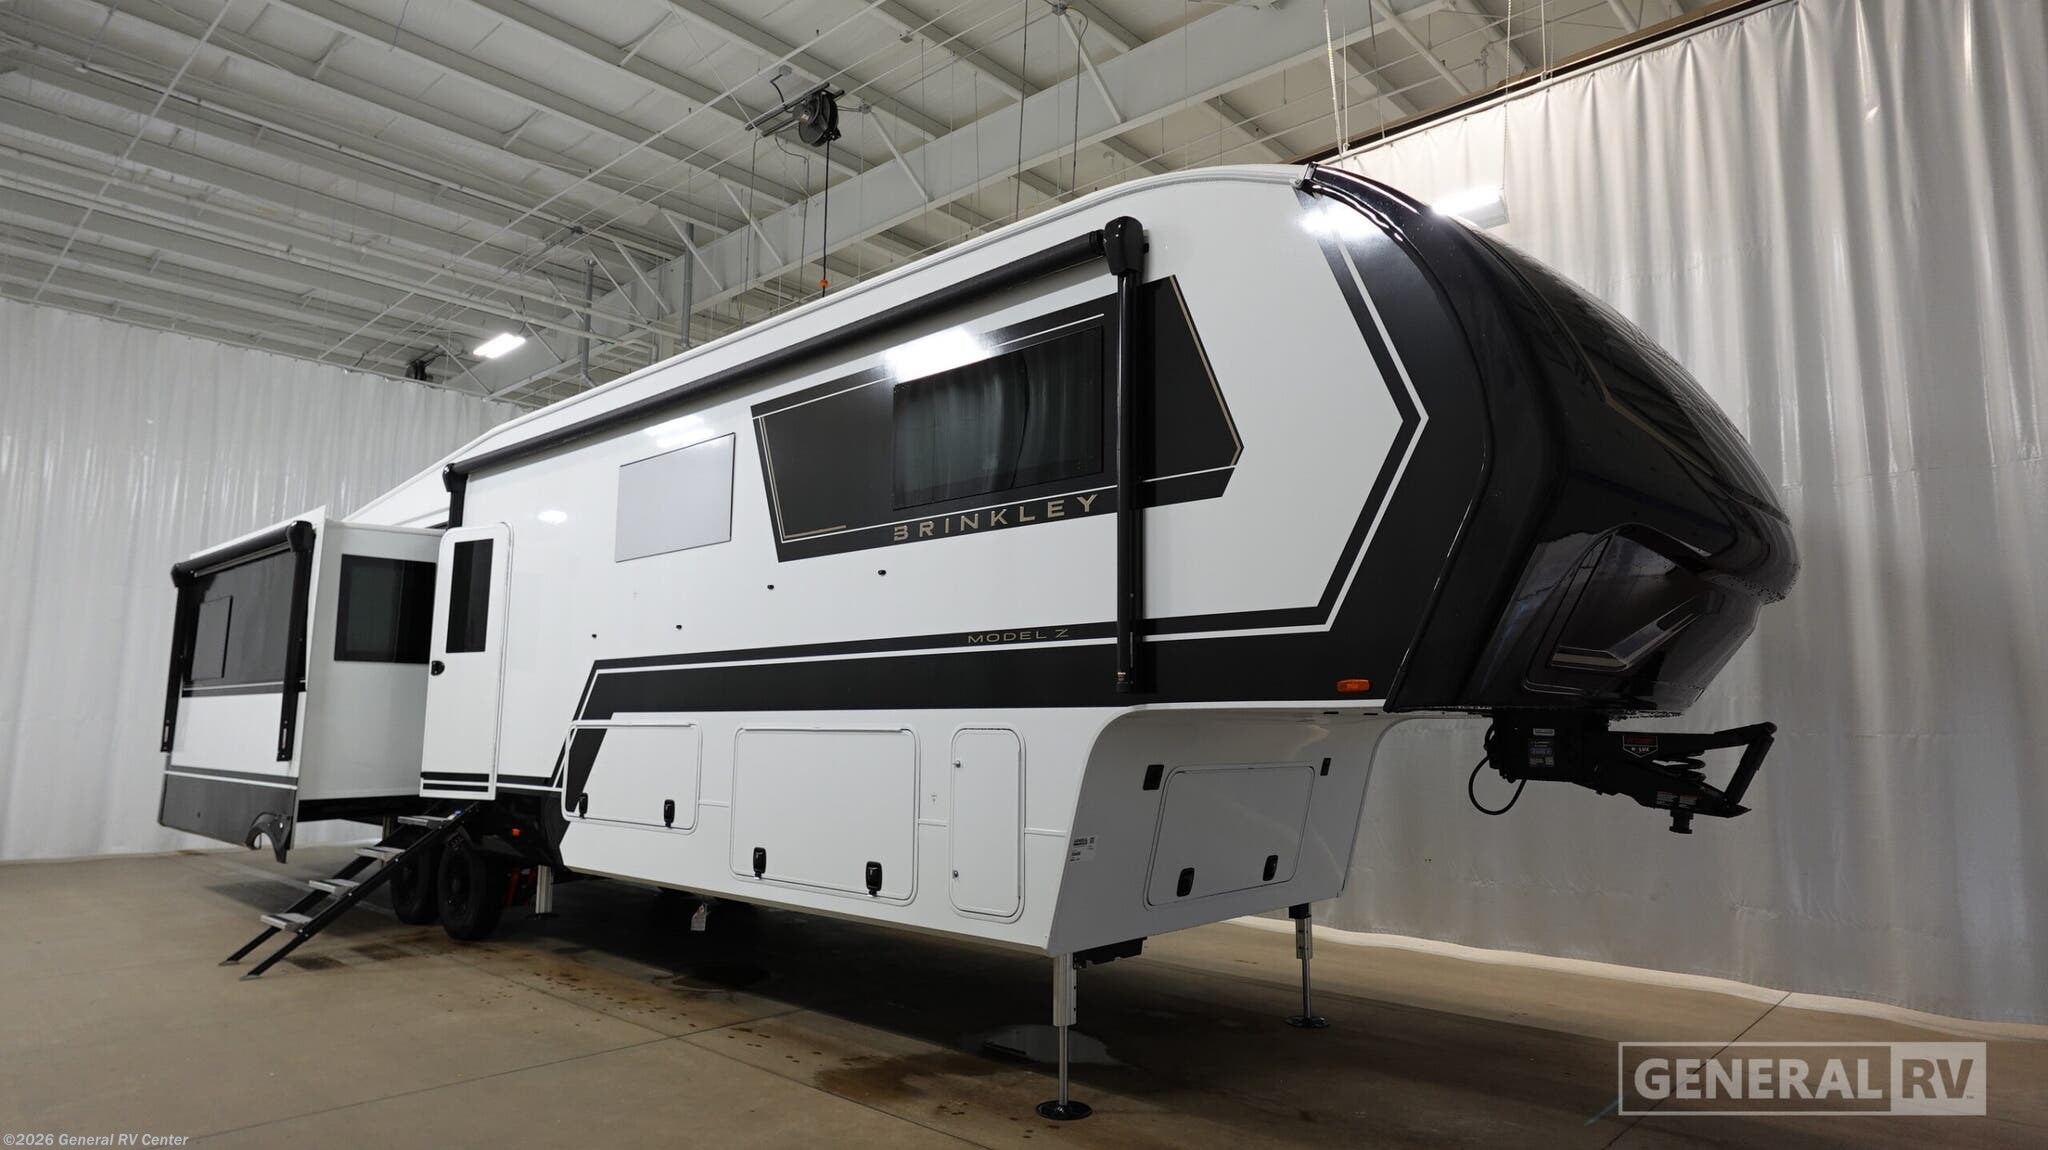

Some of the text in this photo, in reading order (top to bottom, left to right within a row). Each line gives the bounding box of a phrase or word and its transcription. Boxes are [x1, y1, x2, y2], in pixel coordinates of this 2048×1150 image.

[893, 494, 1098, 542] BRINKLEY
[967, 628, 1069, 644] MODEL Z
